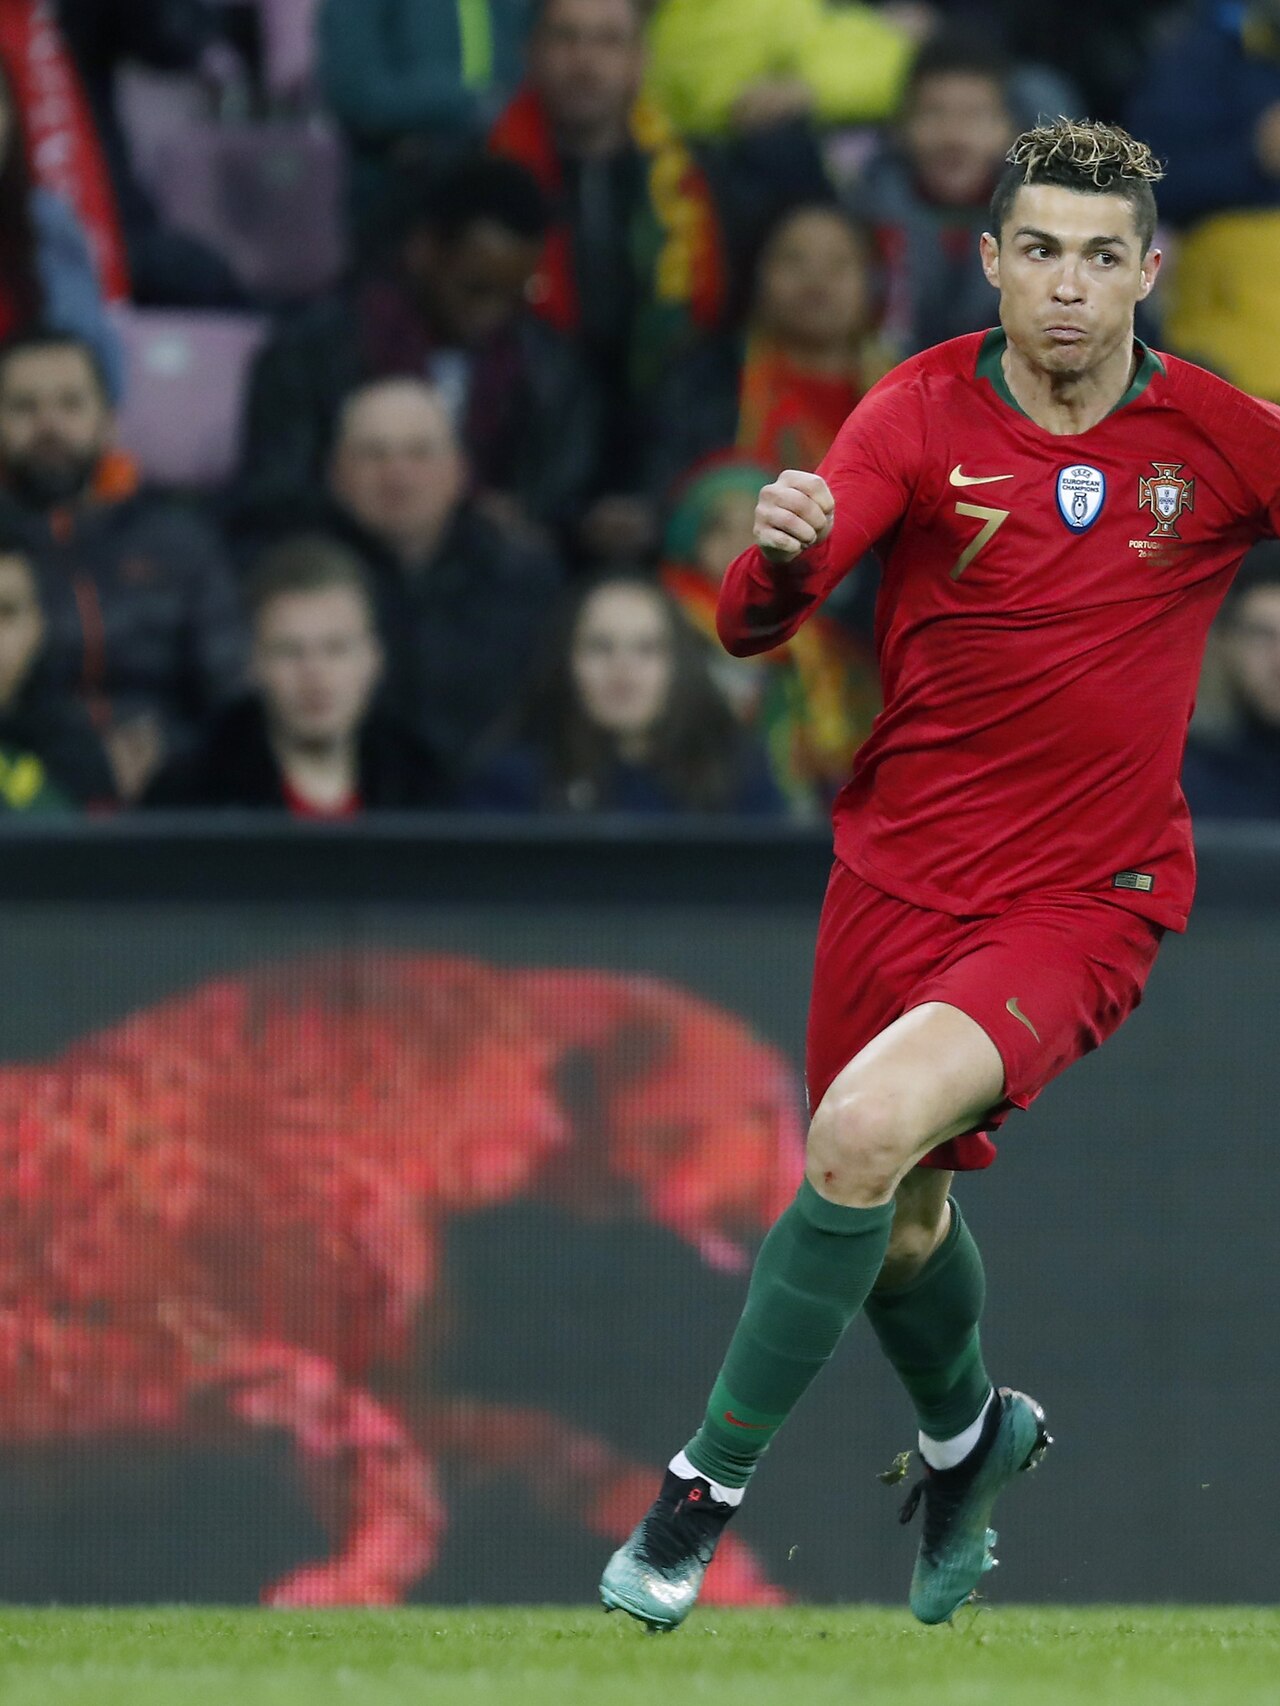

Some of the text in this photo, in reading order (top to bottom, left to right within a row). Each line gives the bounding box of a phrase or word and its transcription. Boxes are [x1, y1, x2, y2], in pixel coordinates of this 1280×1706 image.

[1071, 468, 1093, 479] UEFA
[1062, 478, 1100, 486] EUROPEAN
[949, 501, 1010, 581] 7
[1128, 539, 1166, 550] PORTUG
